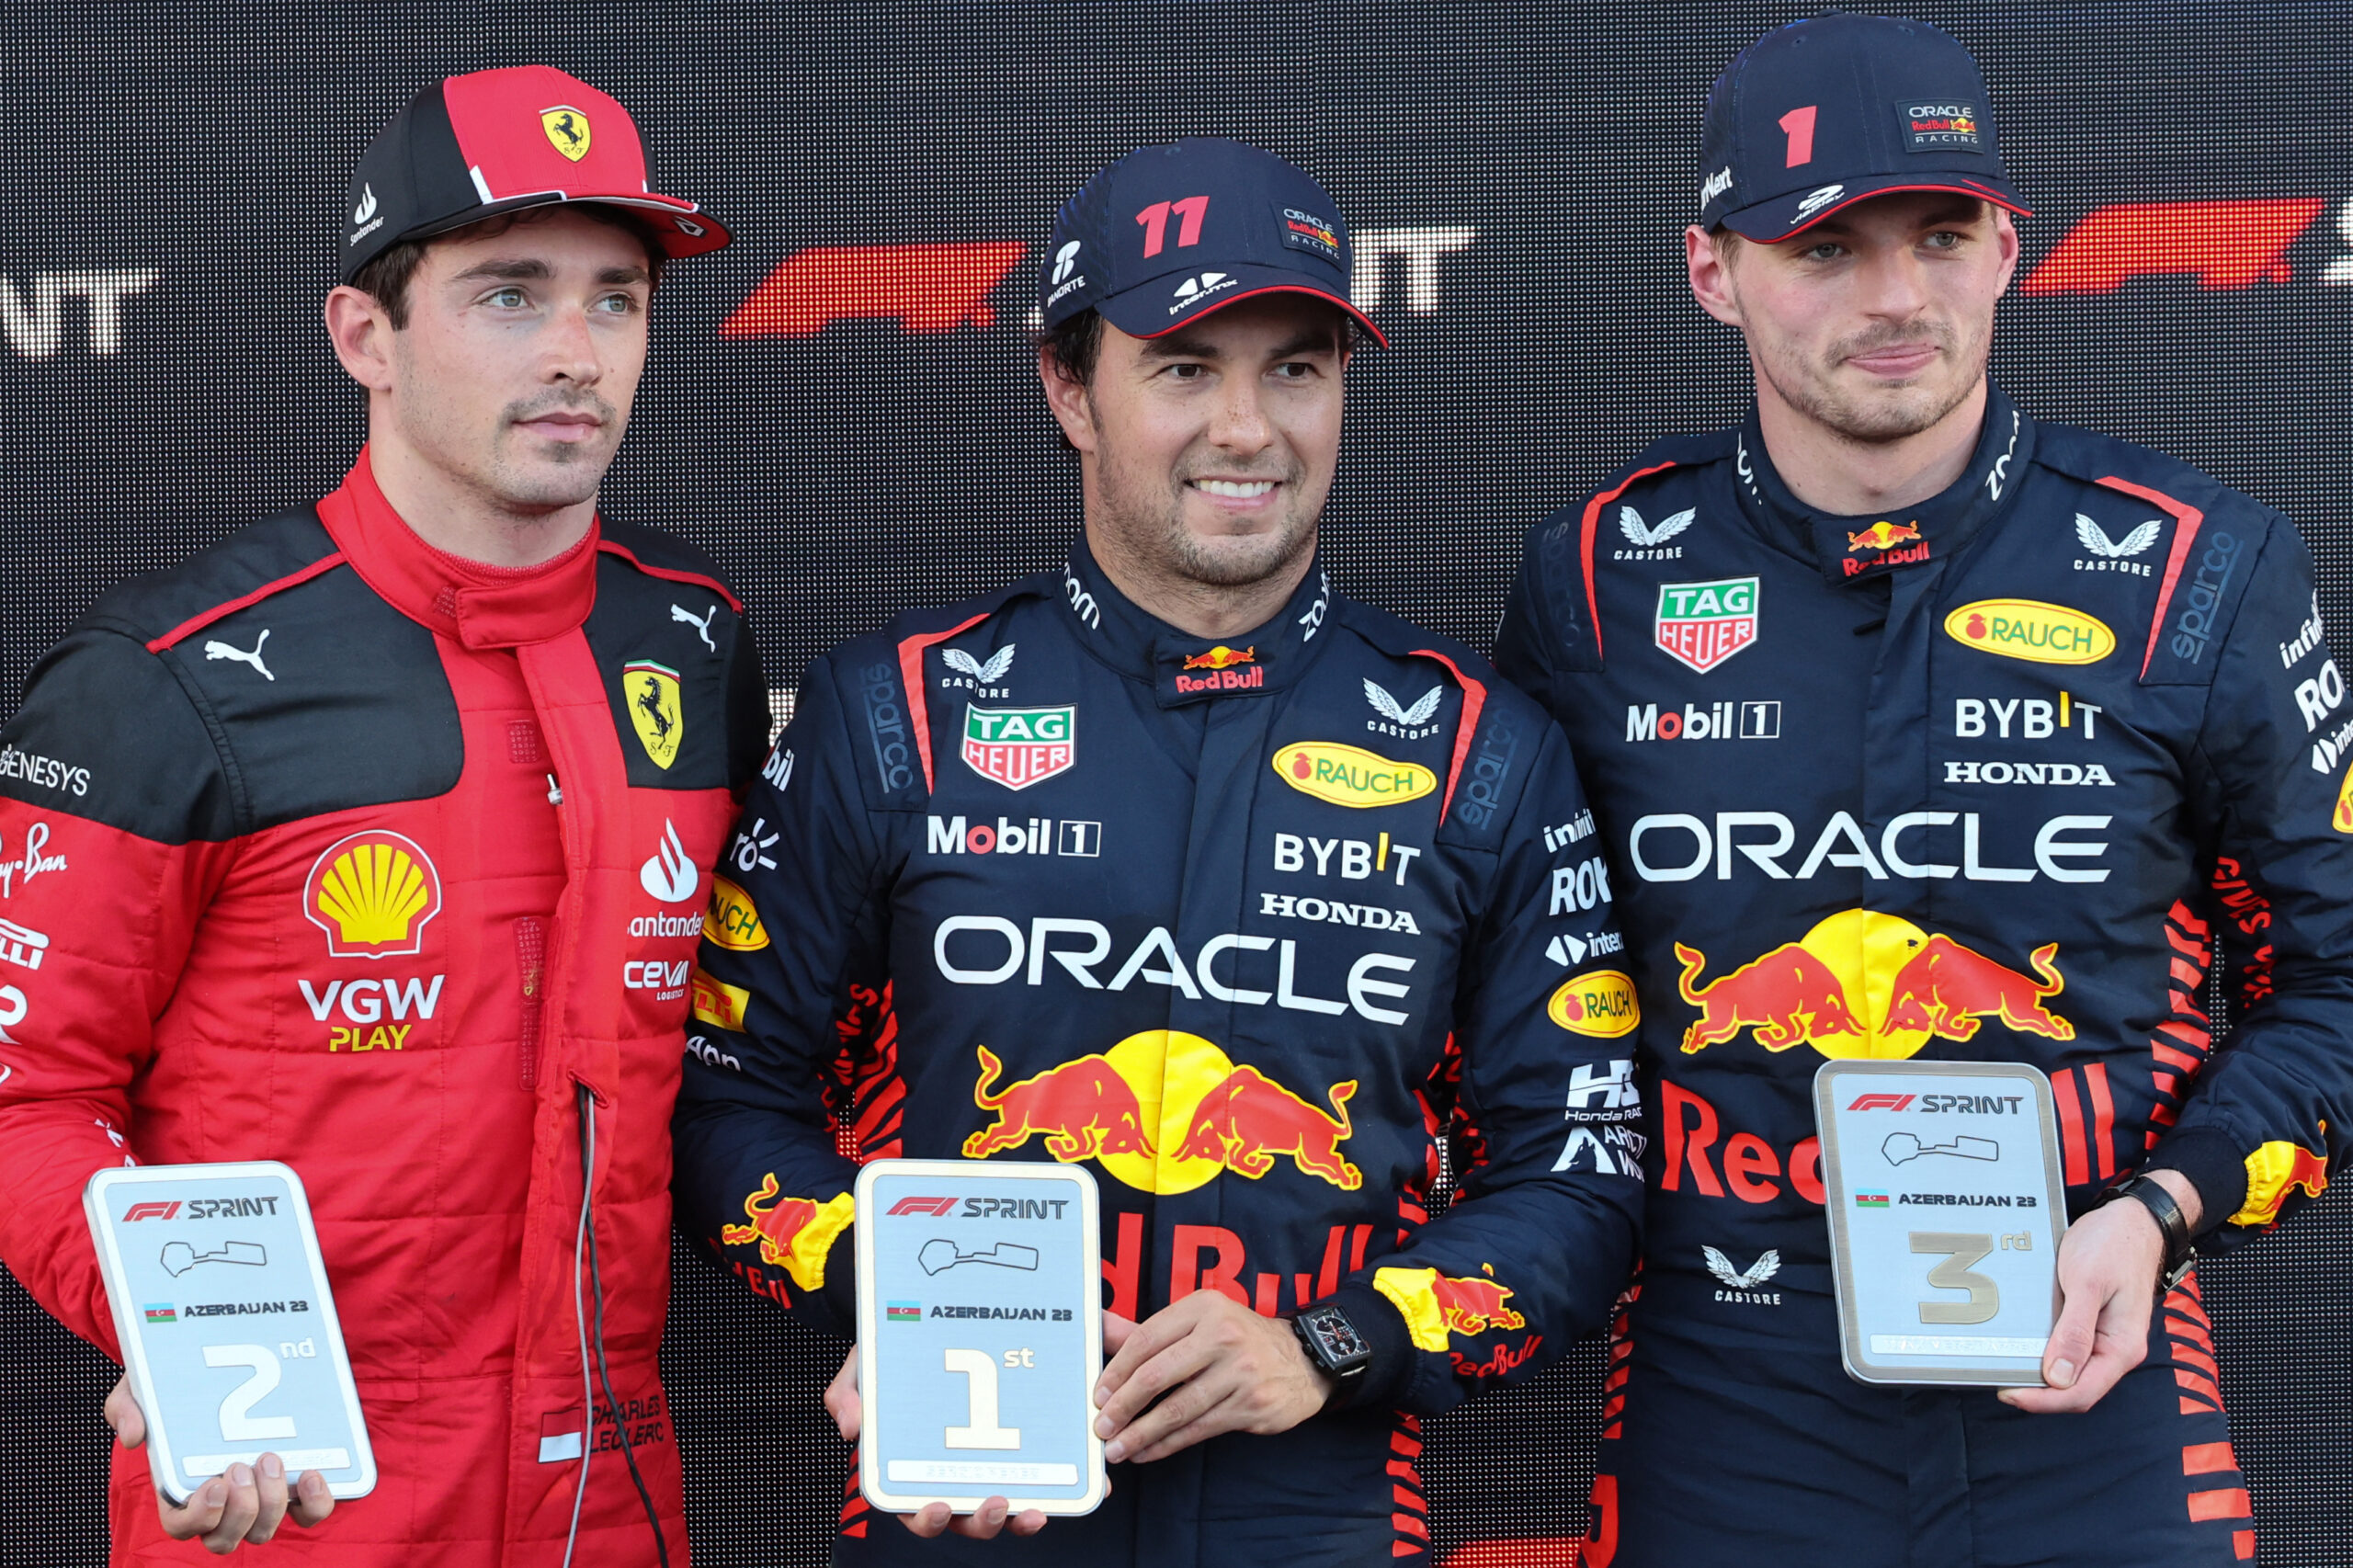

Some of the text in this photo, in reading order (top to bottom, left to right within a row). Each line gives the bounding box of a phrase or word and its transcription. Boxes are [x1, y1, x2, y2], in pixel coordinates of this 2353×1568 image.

[1908, 105, 1973, 119] ORACLE
[1911, 119, 1950, 131] Red Bull
[1778, 106, 1817, 168] 1
[1915, 134, 1978, 144] RACING
[350, 216, 385, 247] Santander
[1135, 196, 1210, 259] 11
[1283, 208, 1336, 235] ORACLE
[1290, 234, 1341, 259] RACING
[1613, 546, 1683, 561] CASTORE
[1887, 540, 1930, 564] Bull
[2074, 559, 2152, 577] CASTORE
[1668, 585, 1750, 616] TAG
[2171, 531, 2241, 664] sparco
[1661, 620, 1750, 666] HEUER
[1991, 617, 2094, 653] RAUCH
[1175, 665, 1264, 693] Red Bull
[862, 663, 915, 793] sparco
[972, 714, 1065, 740] TAG
[1625, 701, 1733, 743] Mobil
[1955, 691, 2103, 740] BYBIT
[1367, 721, 1439, 740] CASTORE
[968, 746, 1067, 782] HEUER
[1315, 758, 1414, 793] RAUCH
[1458, 708, 1518, 829] sparco
[1943, 762, 2117, 787] HONDA
[927, 815, 1051, 855] Mobil
[1629, 810, 2114, 883] ORACLE
[1274, 832, 1421, 887] BYBIT
[1548, 856, 1613, 916] ROK
[627, 910, 705, 938] antande
[1260, 892, 1421, 936] HONDA
[933, 915, 1417, 1027] ORACLE
[297, 974, 446, 1024] VGW
[1584, 990, 1630, 1019] RAUCH
[329, 1023, 412, 1052] PLAY
[1564, 1109, 1623, 1121] Honda
[1919, 1094, 2025, 1115] SPRINT
[188, 1195, 279, 1221] SPRINT
[961, 1197, 1070, 1221] SPRINT
[1898, 1192, 2038, 1208] AZERBAIJAN 23
[184, 1300, 310, 1318] AZERBAIJAN 23
[1714, 1288, 1781, 1305] CASTORE
[930, 1304, 1074, 1322] AZERBAIJAN 23
